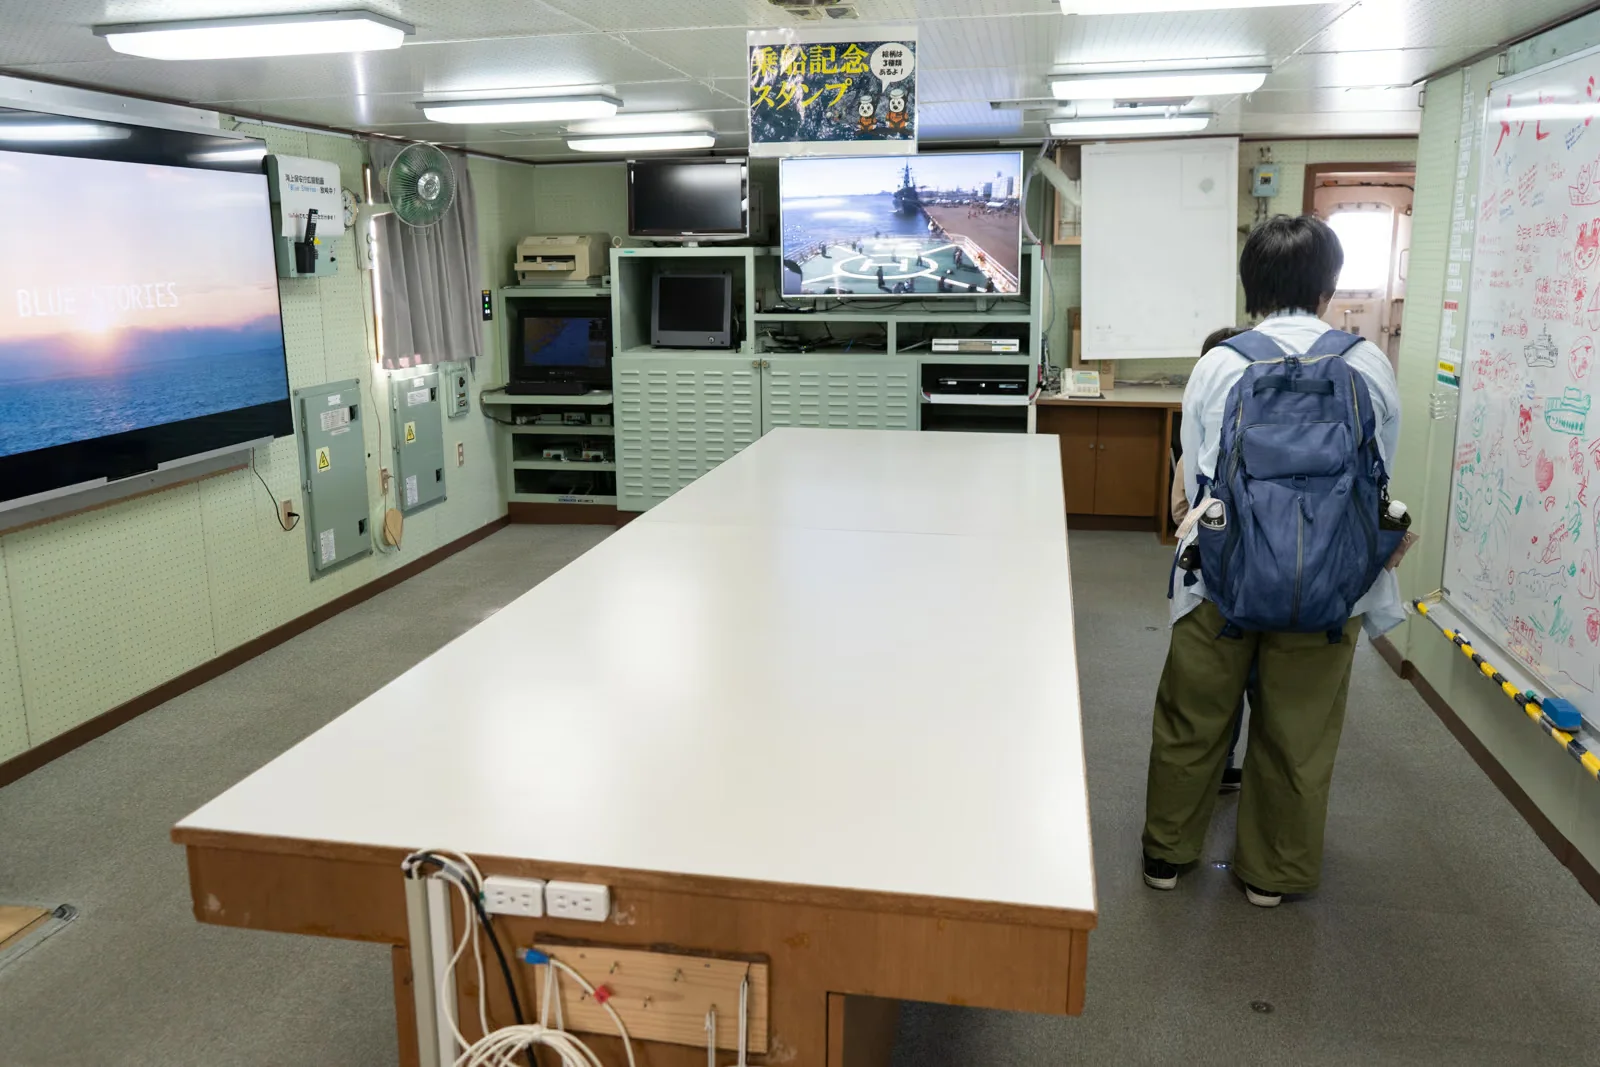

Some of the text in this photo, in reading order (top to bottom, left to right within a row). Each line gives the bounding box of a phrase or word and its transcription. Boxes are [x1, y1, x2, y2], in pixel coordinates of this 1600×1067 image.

[752, 43, 870, 76] 乗船記念
[881, 50, 903, 58] 絵柄は
[751, 77, 853, 110] スタンプ
[16, 282, 179, 318] BLUE STORIES
